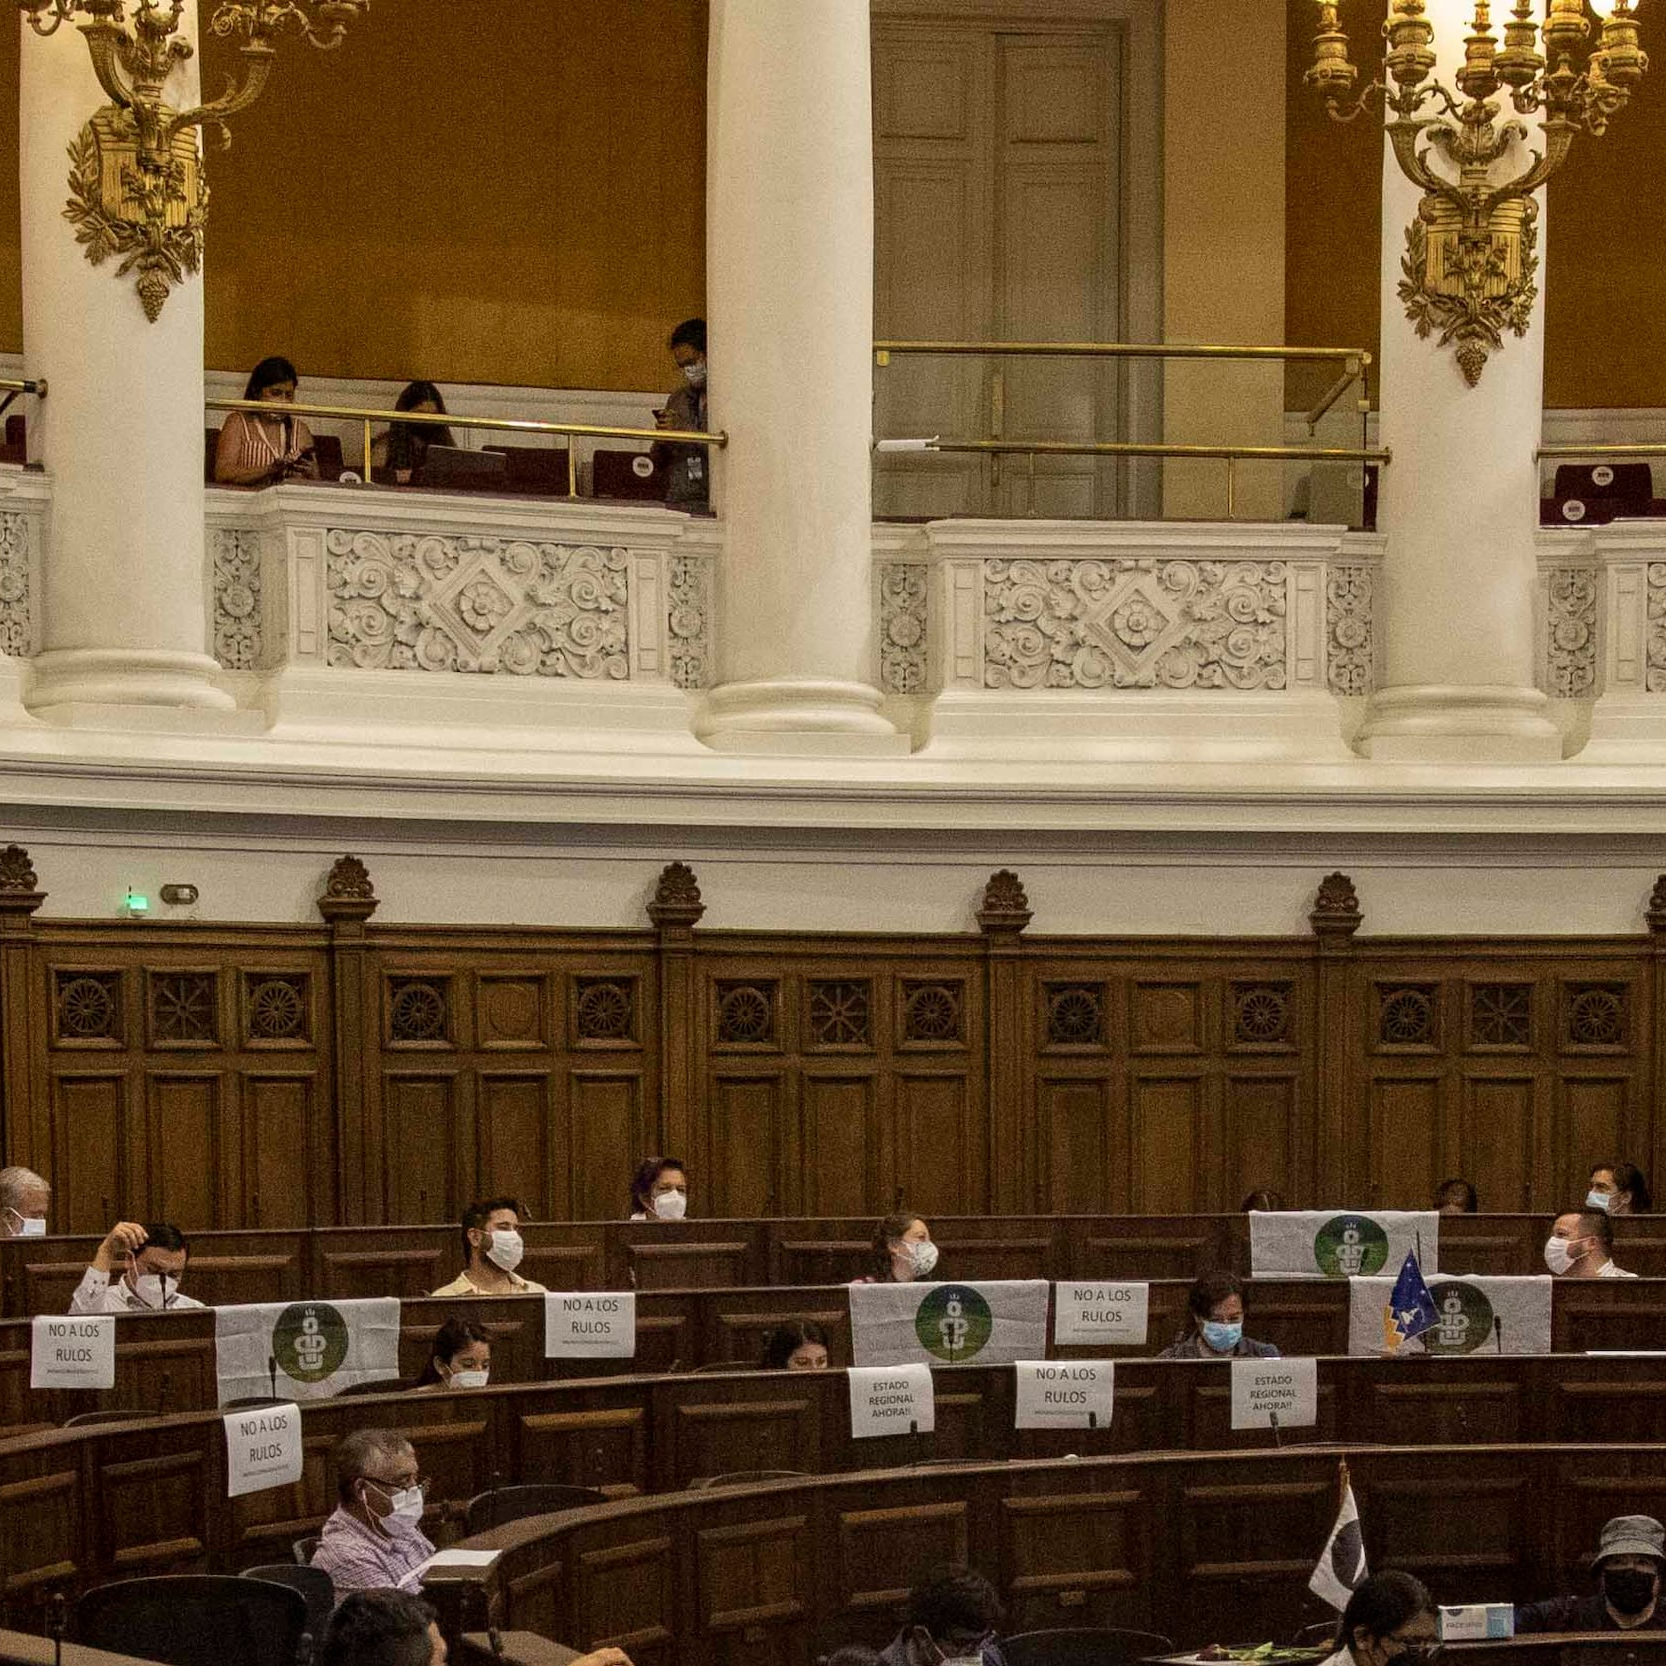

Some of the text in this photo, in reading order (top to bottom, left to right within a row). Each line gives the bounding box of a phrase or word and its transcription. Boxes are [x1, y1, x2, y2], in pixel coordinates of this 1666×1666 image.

[1074, 1289, 1132, 1302] NO A LOS
[563, 1299, 619, 1312] NO A LOS
[1082, 1310, 1122, 1322] RULOS
[48, 1324, 100, 1338] NO A LOS
[571, 1321, 611, 1333] RULOS
[56, 1349, 93, 1362] RULOS
[1036, 1367, 1097, 1381] NO A LOS
[873, 1381, 909, 1391] ESTADO
[1255, 1375, 1293, 1386] ESTADO
[869, 1394, 914, 1406] REGIONAL
[1044, 1391, 1087, 1403] RULOS
[1250, 1389, 1297, 1399] REGIONAL
[240, 1415, 288, 1436] NO A LOS
[249, 1443, 283, 1462] RULOS
